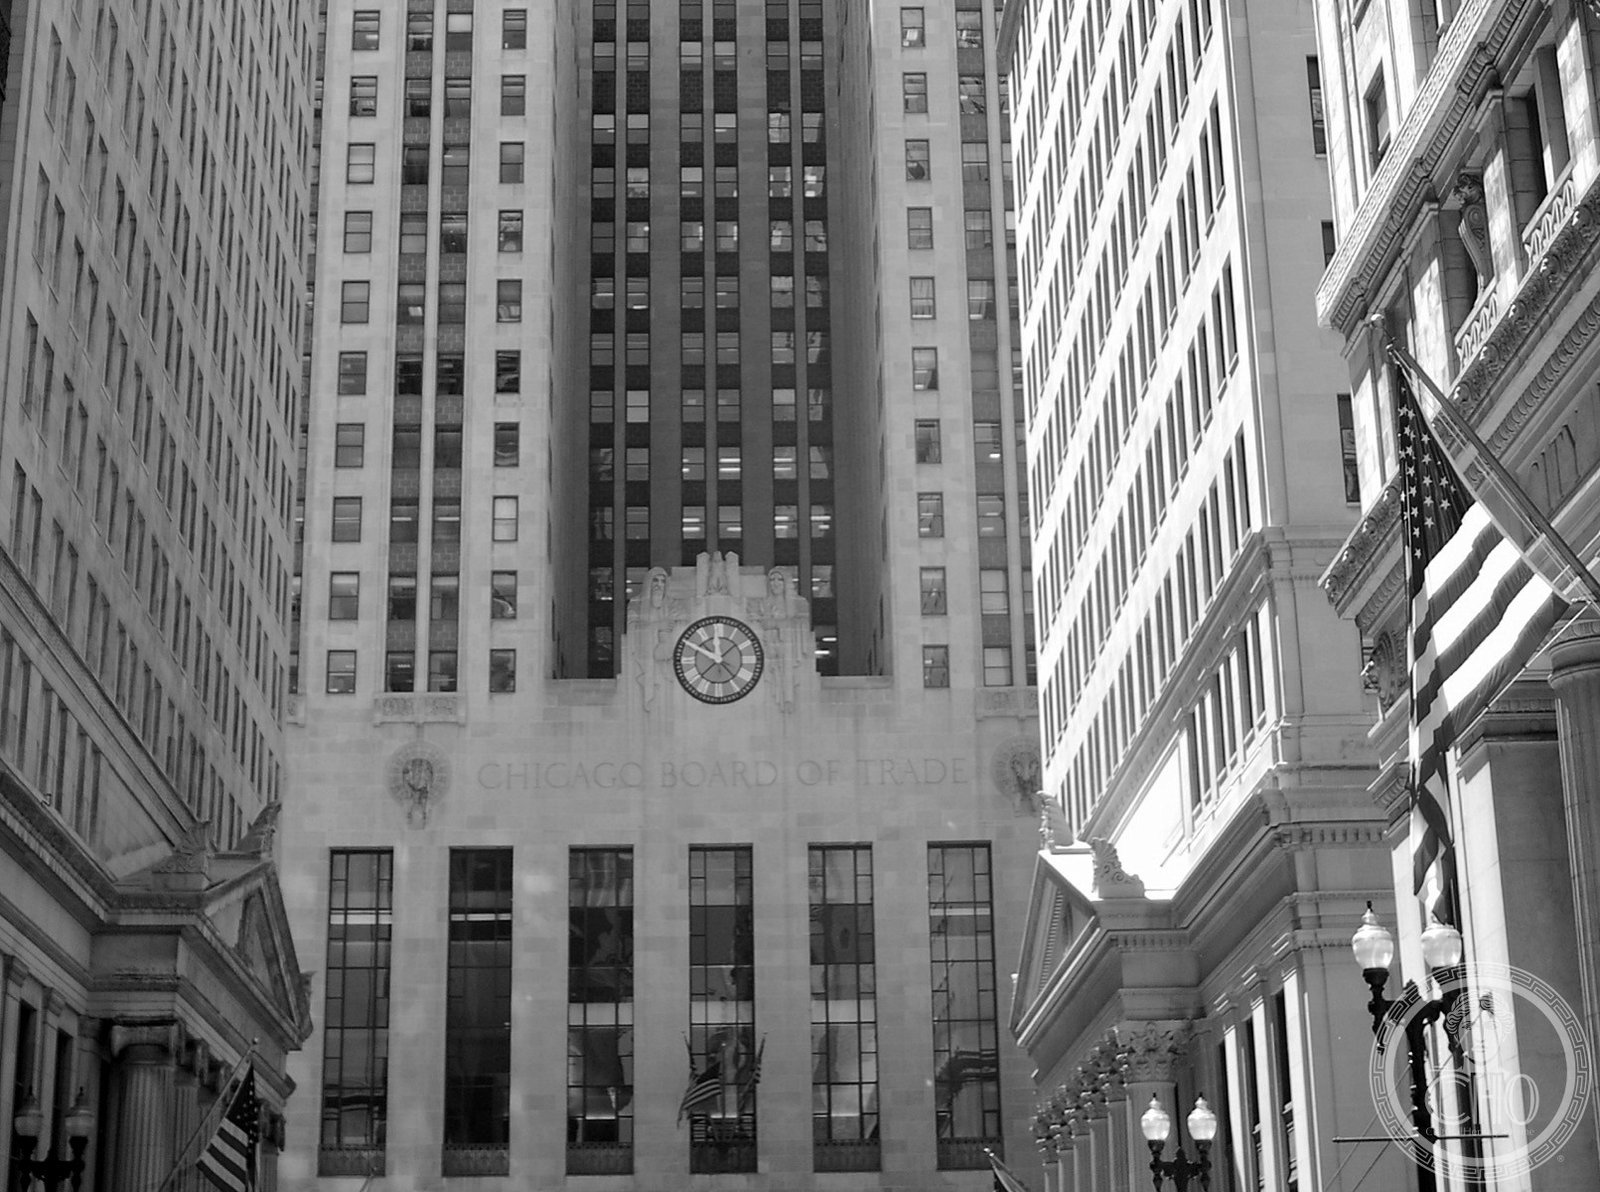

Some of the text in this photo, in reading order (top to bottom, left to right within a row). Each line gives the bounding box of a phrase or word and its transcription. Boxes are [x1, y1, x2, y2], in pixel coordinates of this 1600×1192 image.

[477, 757, 969, 789] CHICAGO BOARD OF TRADE
